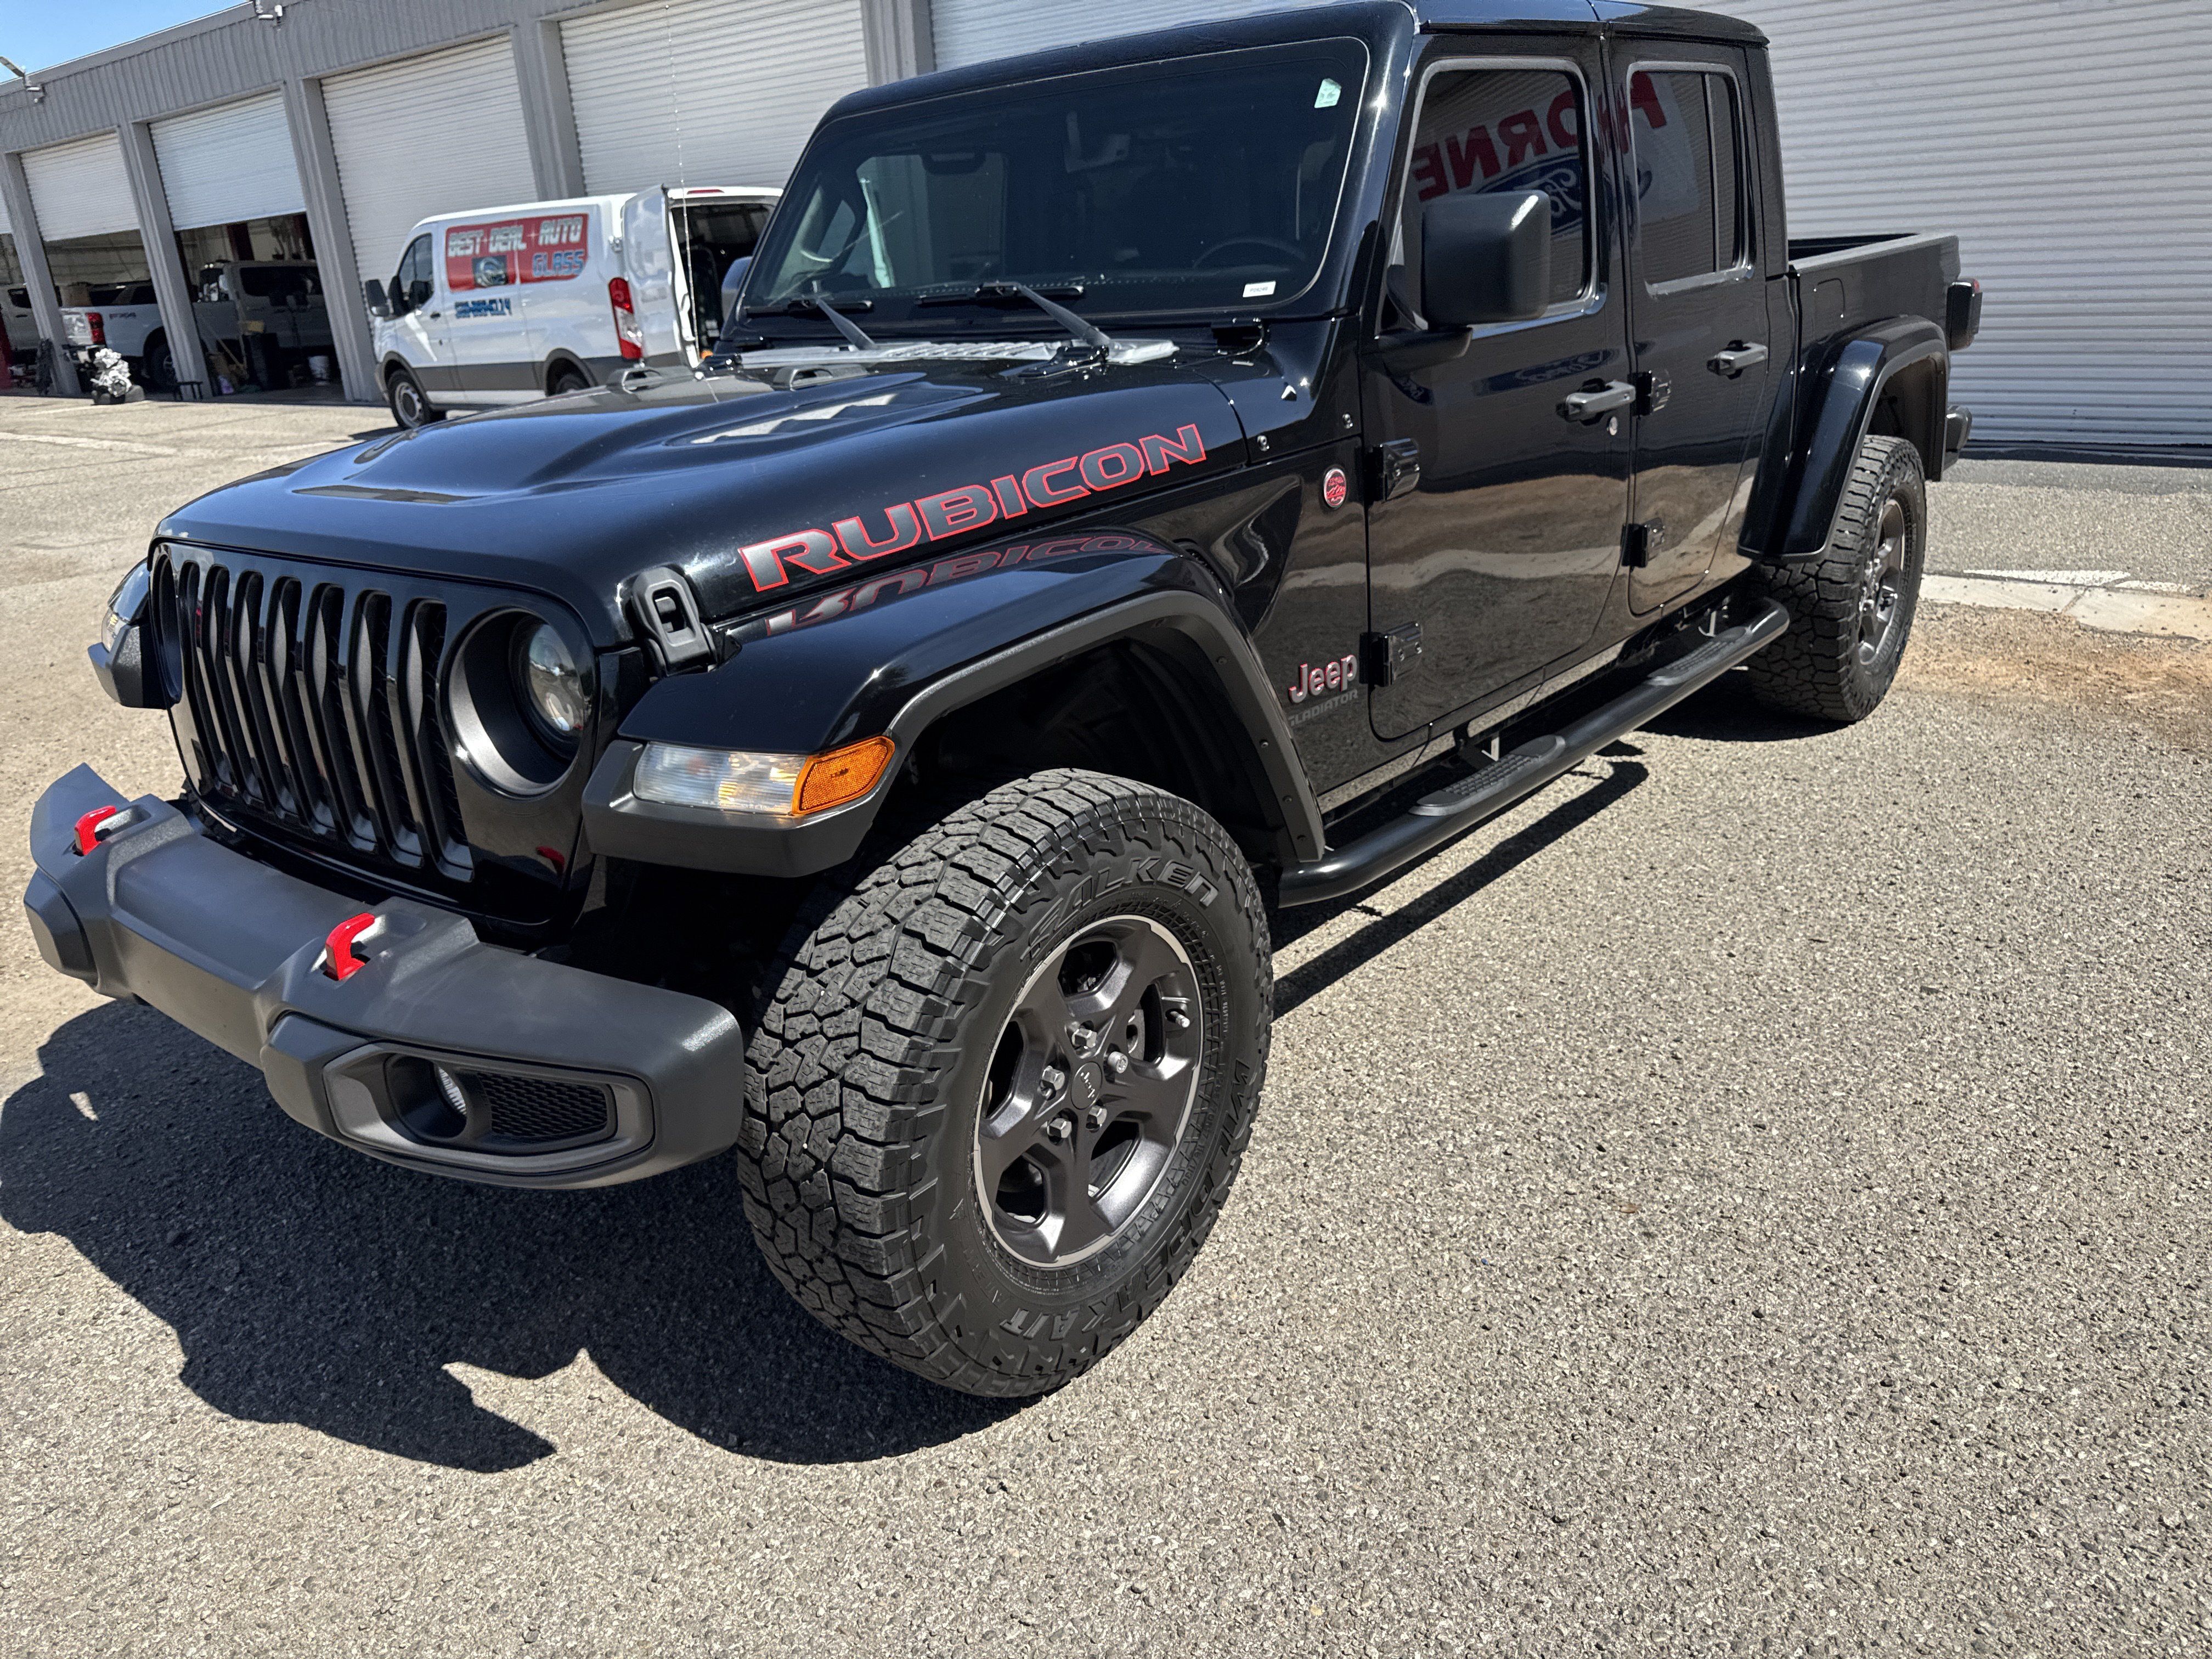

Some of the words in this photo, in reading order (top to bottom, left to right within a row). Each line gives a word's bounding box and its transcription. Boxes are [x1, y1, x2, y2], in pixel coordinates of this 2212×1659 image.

[448, 230, 483, 257] BEST
[489, 225, 527, 252] DEAL
[539, 217, 583, 245] AUTO
[533, 250, 584, 277] GLASS
[740, 424, 1206, 592] RUBICON
[1289, 654, 1358, 704] Jeep
